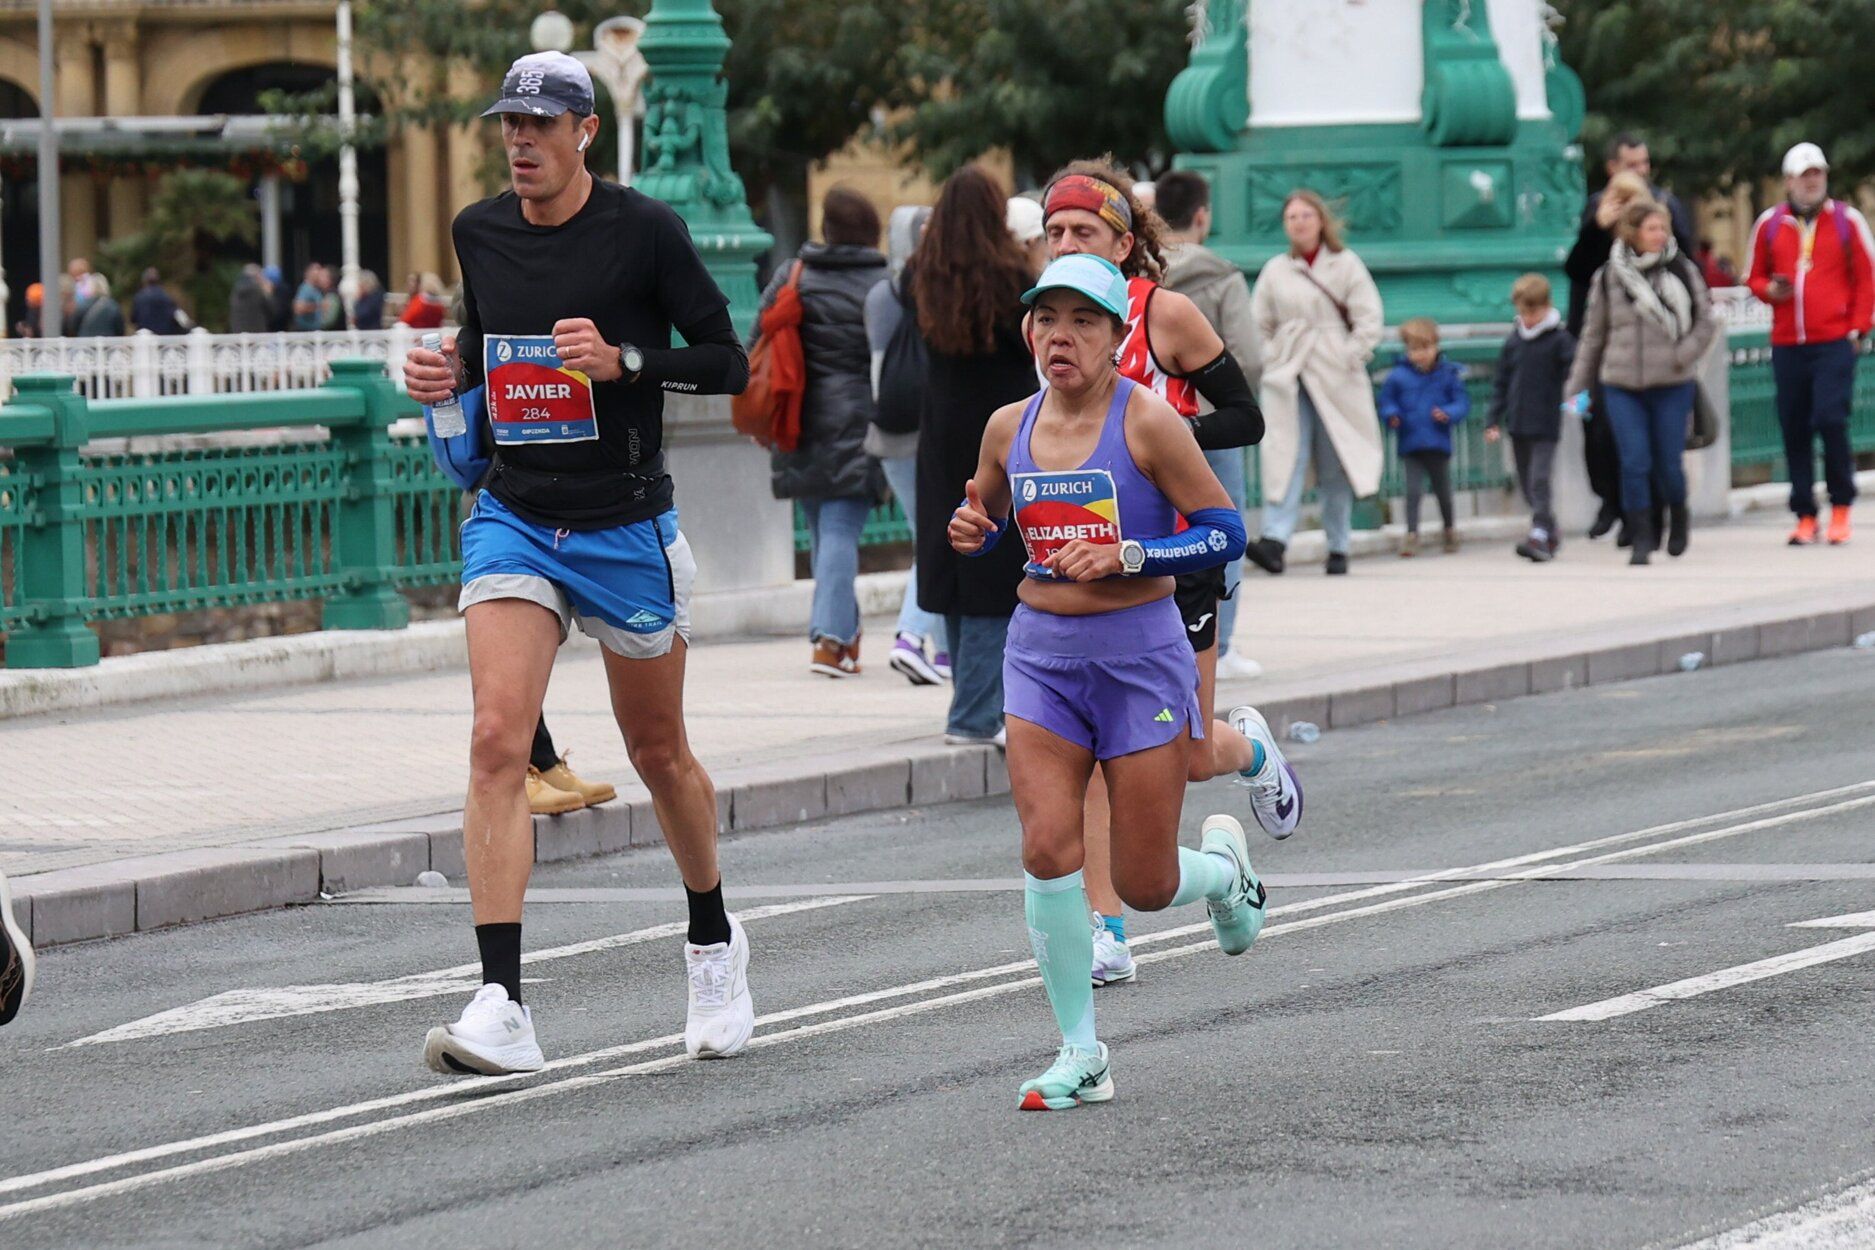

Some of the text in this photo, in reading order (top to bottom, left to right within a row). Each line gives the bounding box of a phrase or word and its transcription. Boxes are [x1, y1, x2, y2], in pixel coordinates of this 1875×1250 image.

[516, 70, 545, 94] 365
[517, 346, 557, 358] ZURIC
[505, 384, 571, 400] JAVIER
[660, 380, 698, 391] KIPRUN
[522, 407, 551, 420] 284
[1041, 481, 1092, 496] ZURICH
[1027, 523, 1115, 542] ELIZABETH
[1145, 540, 1208, 559] Banamex
